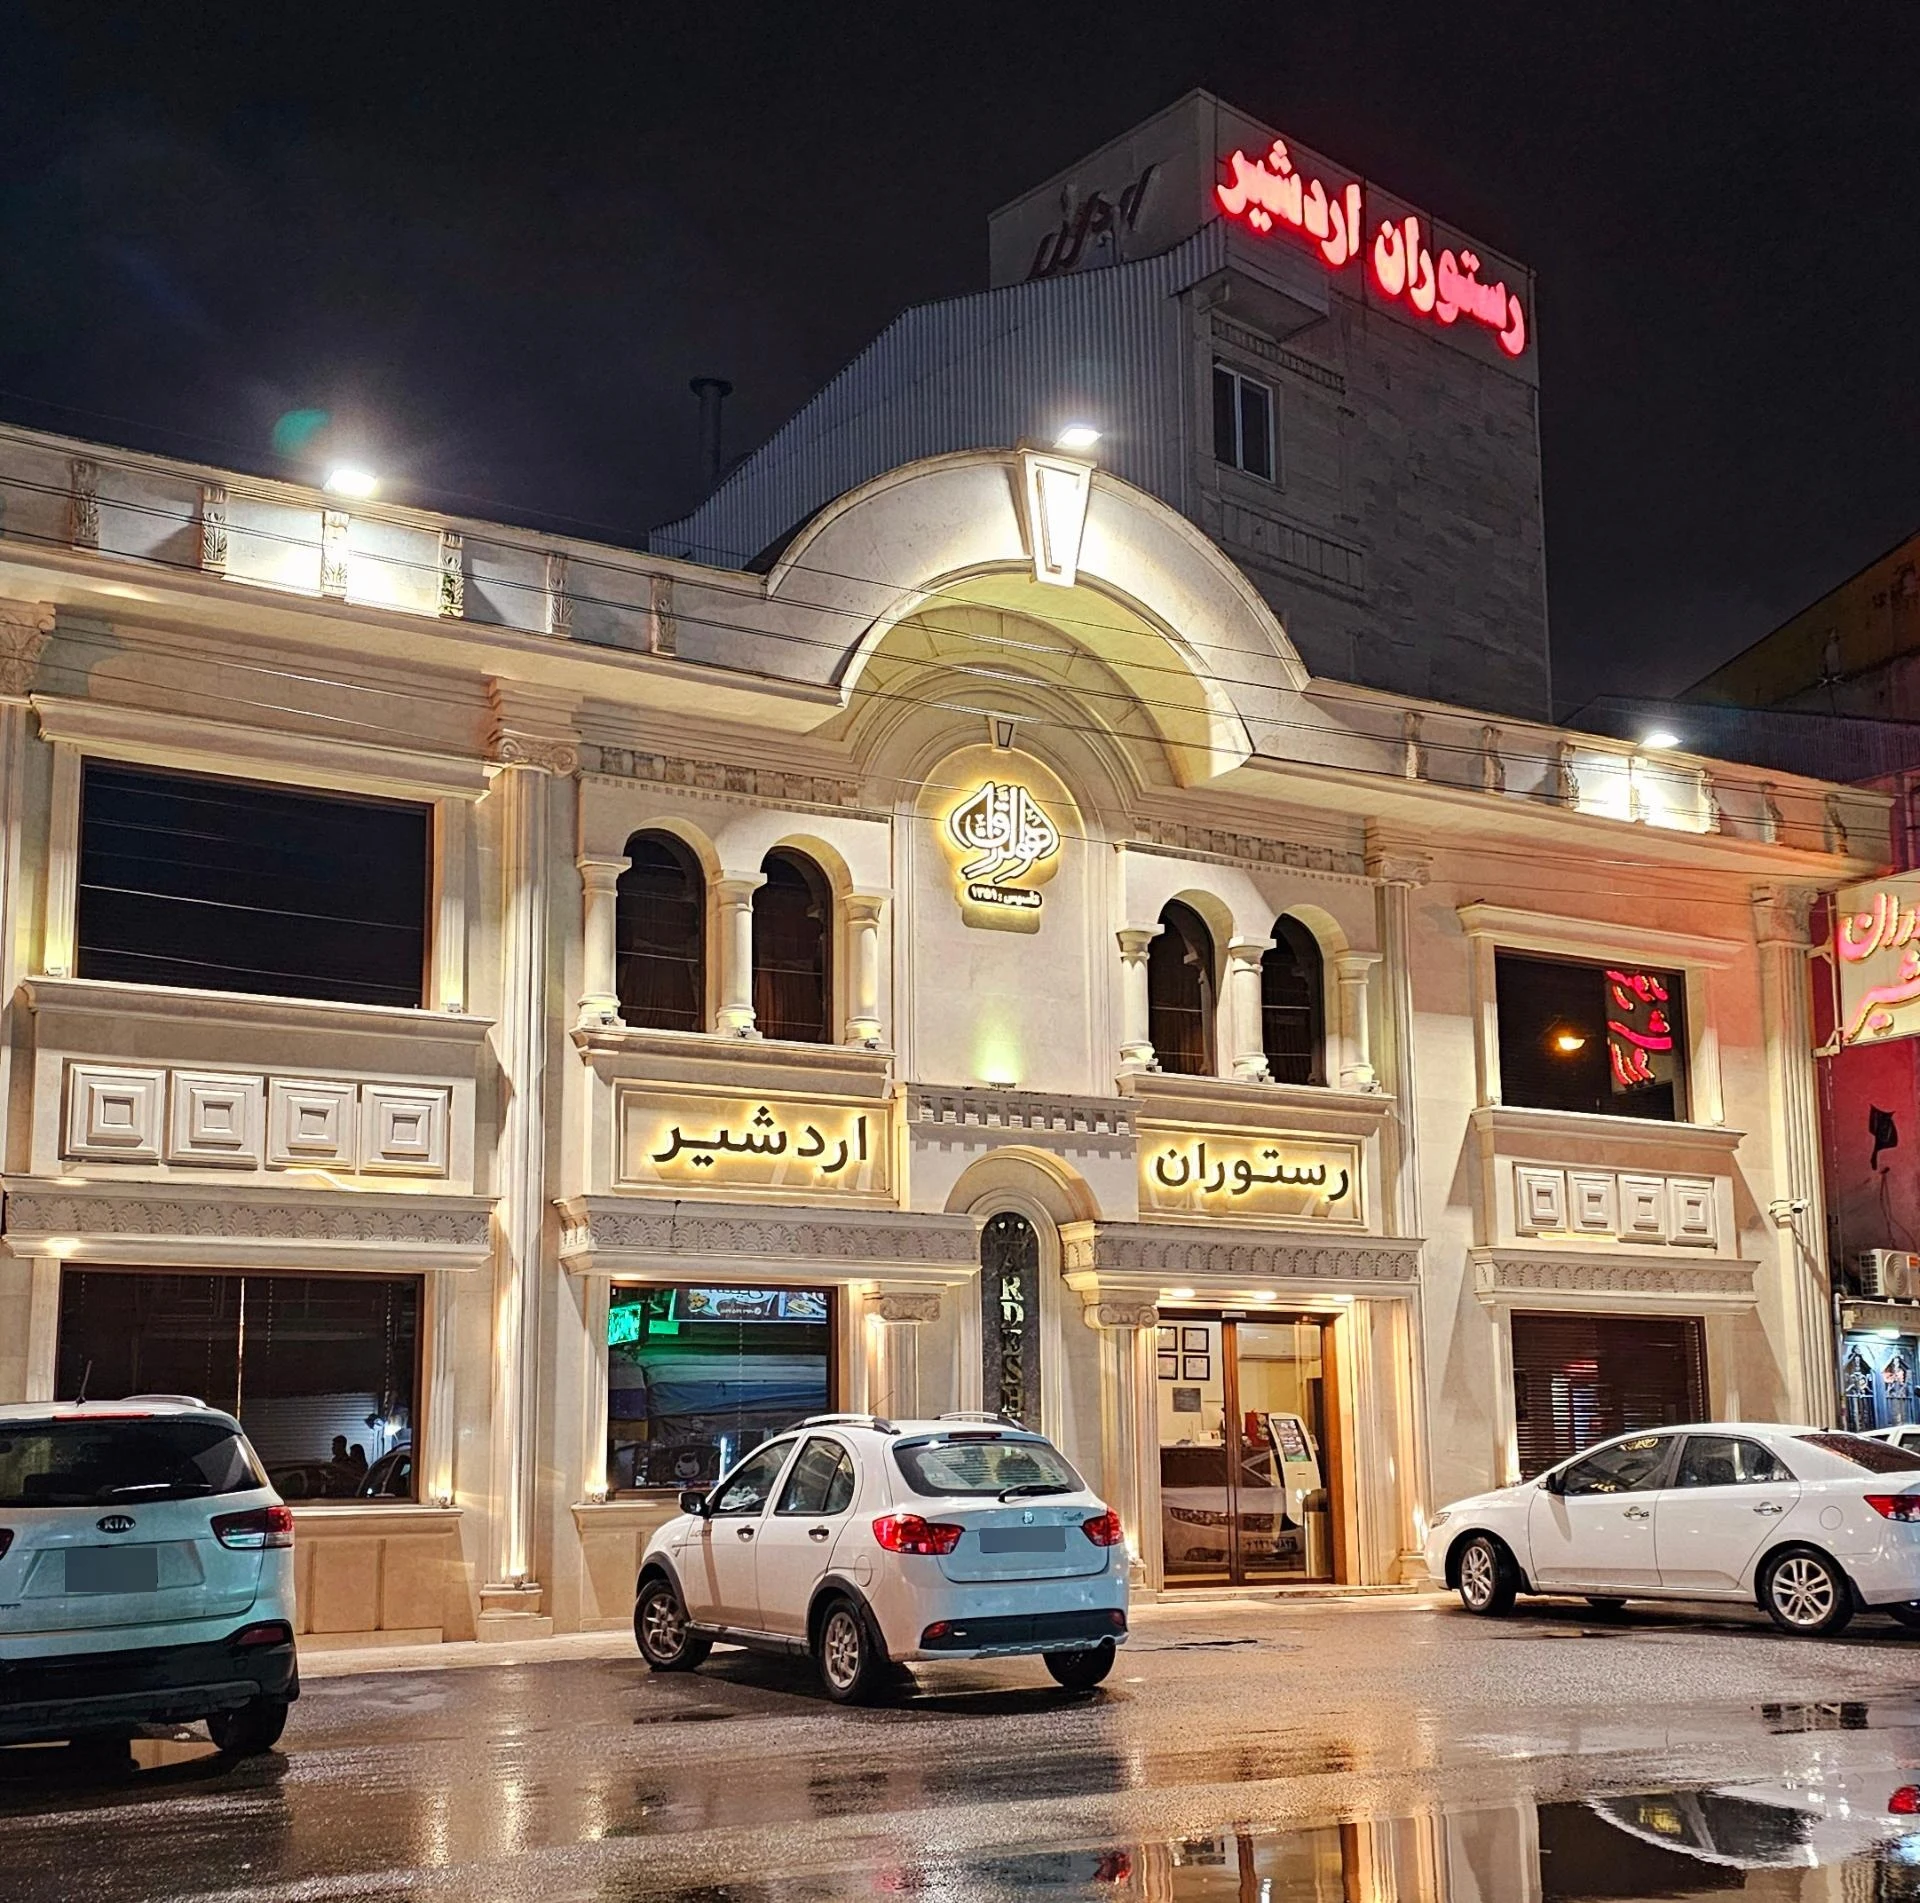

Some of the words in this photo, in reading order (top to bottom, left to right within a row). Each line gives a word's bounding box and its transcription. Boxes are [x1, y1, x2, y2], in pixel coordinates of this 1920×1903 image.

[1217, 139, 1362, 267] اردشیر
[1373, 215, 1525, 355] رستوران
[652, 1105, 868, 1174] اردشیر
[1156, 1142, 1349, 1202] رستوران
[104, 1519, 131, 1529] KIA
